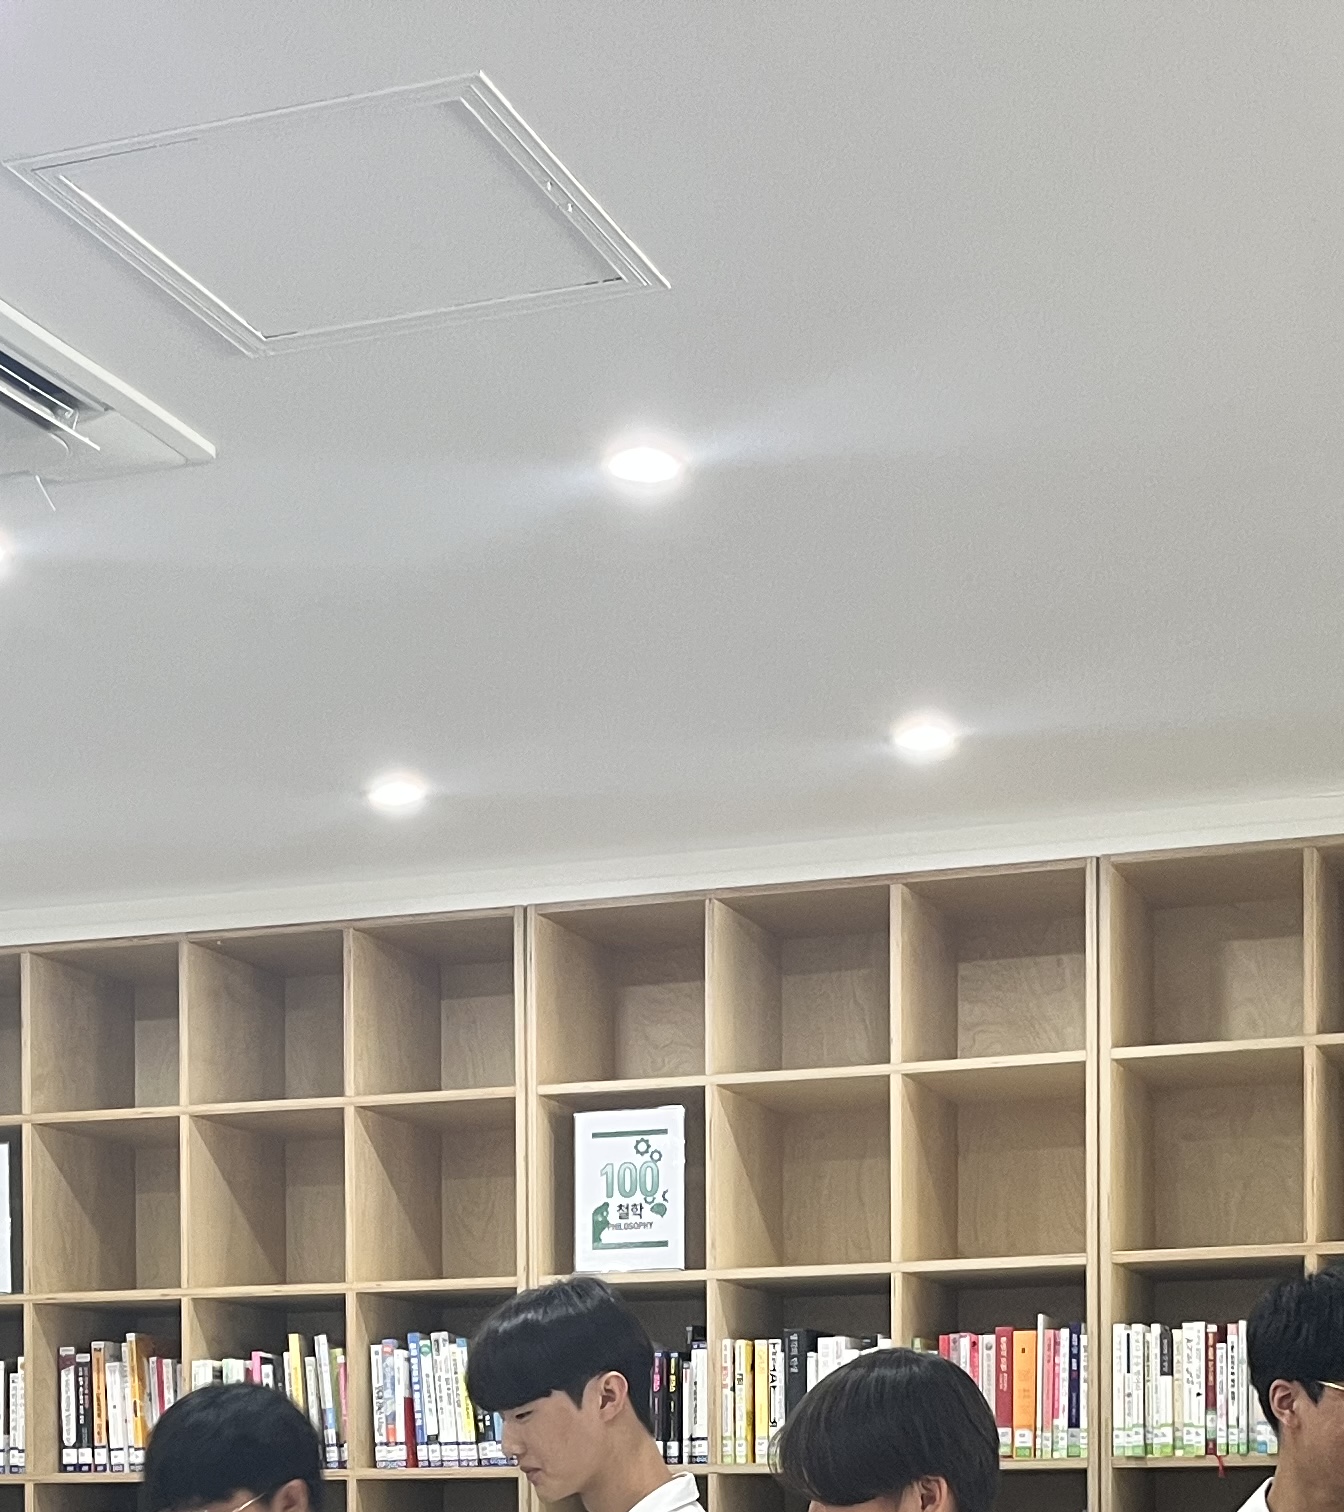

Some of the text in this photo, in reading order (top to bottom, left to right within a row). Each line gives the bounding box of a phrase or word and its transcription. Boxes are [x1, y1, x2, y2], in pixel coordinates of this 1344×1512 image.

[600, 1160, 660, 1198] 100
[616, 1202, 644, 1220] 철학
[607, 1221, 654, 1231] PHILOSOPHY
